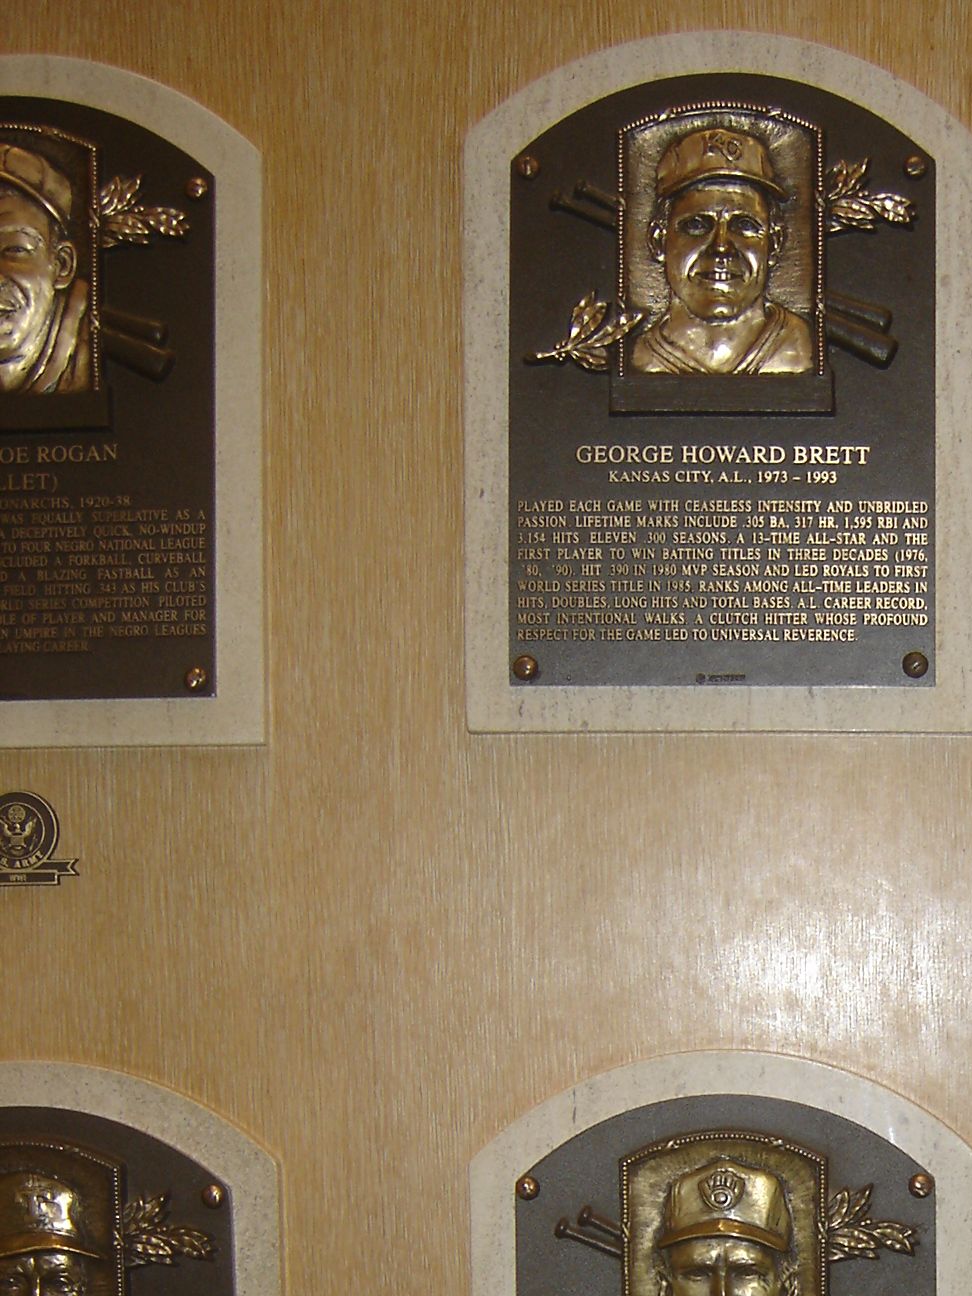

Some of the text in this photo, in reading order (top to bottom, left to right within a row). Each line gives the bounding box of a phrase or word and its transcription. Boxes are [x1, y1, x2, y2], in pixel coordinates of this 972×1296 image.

[37, 443, 118, 463] ROGAN
[576, 445, 870, 465] GEORGE HOWARD BRETT
[608, 470, 670, 483] KANSAS
[757, 470, 788, 483] 1973
[805, 470, 838, 483] 1993
[517, 500, 929, 513] PLAYED EACH GAME WITH CEASELESS INTENSITY AND UNBRIDLED
[575, 516, 631, 528] LIFETIME
[636, 516, 679, 528] MARKS
[684, 516, 738, 529] INCLUDE
[794, 516, 813, 529] 317
[877, 516, 898, 529] RBI
[902, 516, 929, 529] AND
[160, 538, 206, 549] LEAGUE
[590, 532, 637, 544] ELEVEN
[736, 532, 744, 545] A
[872, 532, 898, 545] AND
[905, 532, 929, 545] THE
[138, 552, 206, 565] CURVEBALL
[517, 548, 551, 560] FIRST
[557, 548, 602, 560] PLAYER
[609, 548, 625, 560] TO
[632, 548, 655, 560] WIN
[662, 548, 714, 560] BATTING
[720, 548, 761, 561] TITLES
[767, 548, 781, 561] IN
[787, 548, 826, 561] THREE
[833, 548, 888, 561] DECADES
[581, 564, 928, 577] HIT IN 1980 MVP SEASON AND LED ROYALS TO FIRST
[517, 580, 561, 592] WORLD
[565, 580, 606, 592] SERIES
[610, 580, 644, 592] TITLE
[649, 580, 661, 592] IN
[699, 580, 739, 593] RANKS
[743, 580, 788, 593] AMONG
[855, 580, 911, 593] LEADERS
[915, 580, 928, 593] IN
[159, 595, 206, 607] PILOTED
[614, 596, 872, 609] LONG HITS AND TOTAL CAREER
[121, 610, 206, 622] MANAGER FOR
[517, 612, 929, 625] MOST INTENTIONAL A CLUTCH HITTER WHOSE PROFOUND
[517, 628, 568, 640] RESPECT
[572, 628, 596, 640] FOR
[600, 628, 623, 640] THE
[626, 628, 661, 640] GAME
[665, 628, 688, 640] LED
[692, 628, 708, 640] TO
[711, 629, 780, 641] UNIVERSAL
